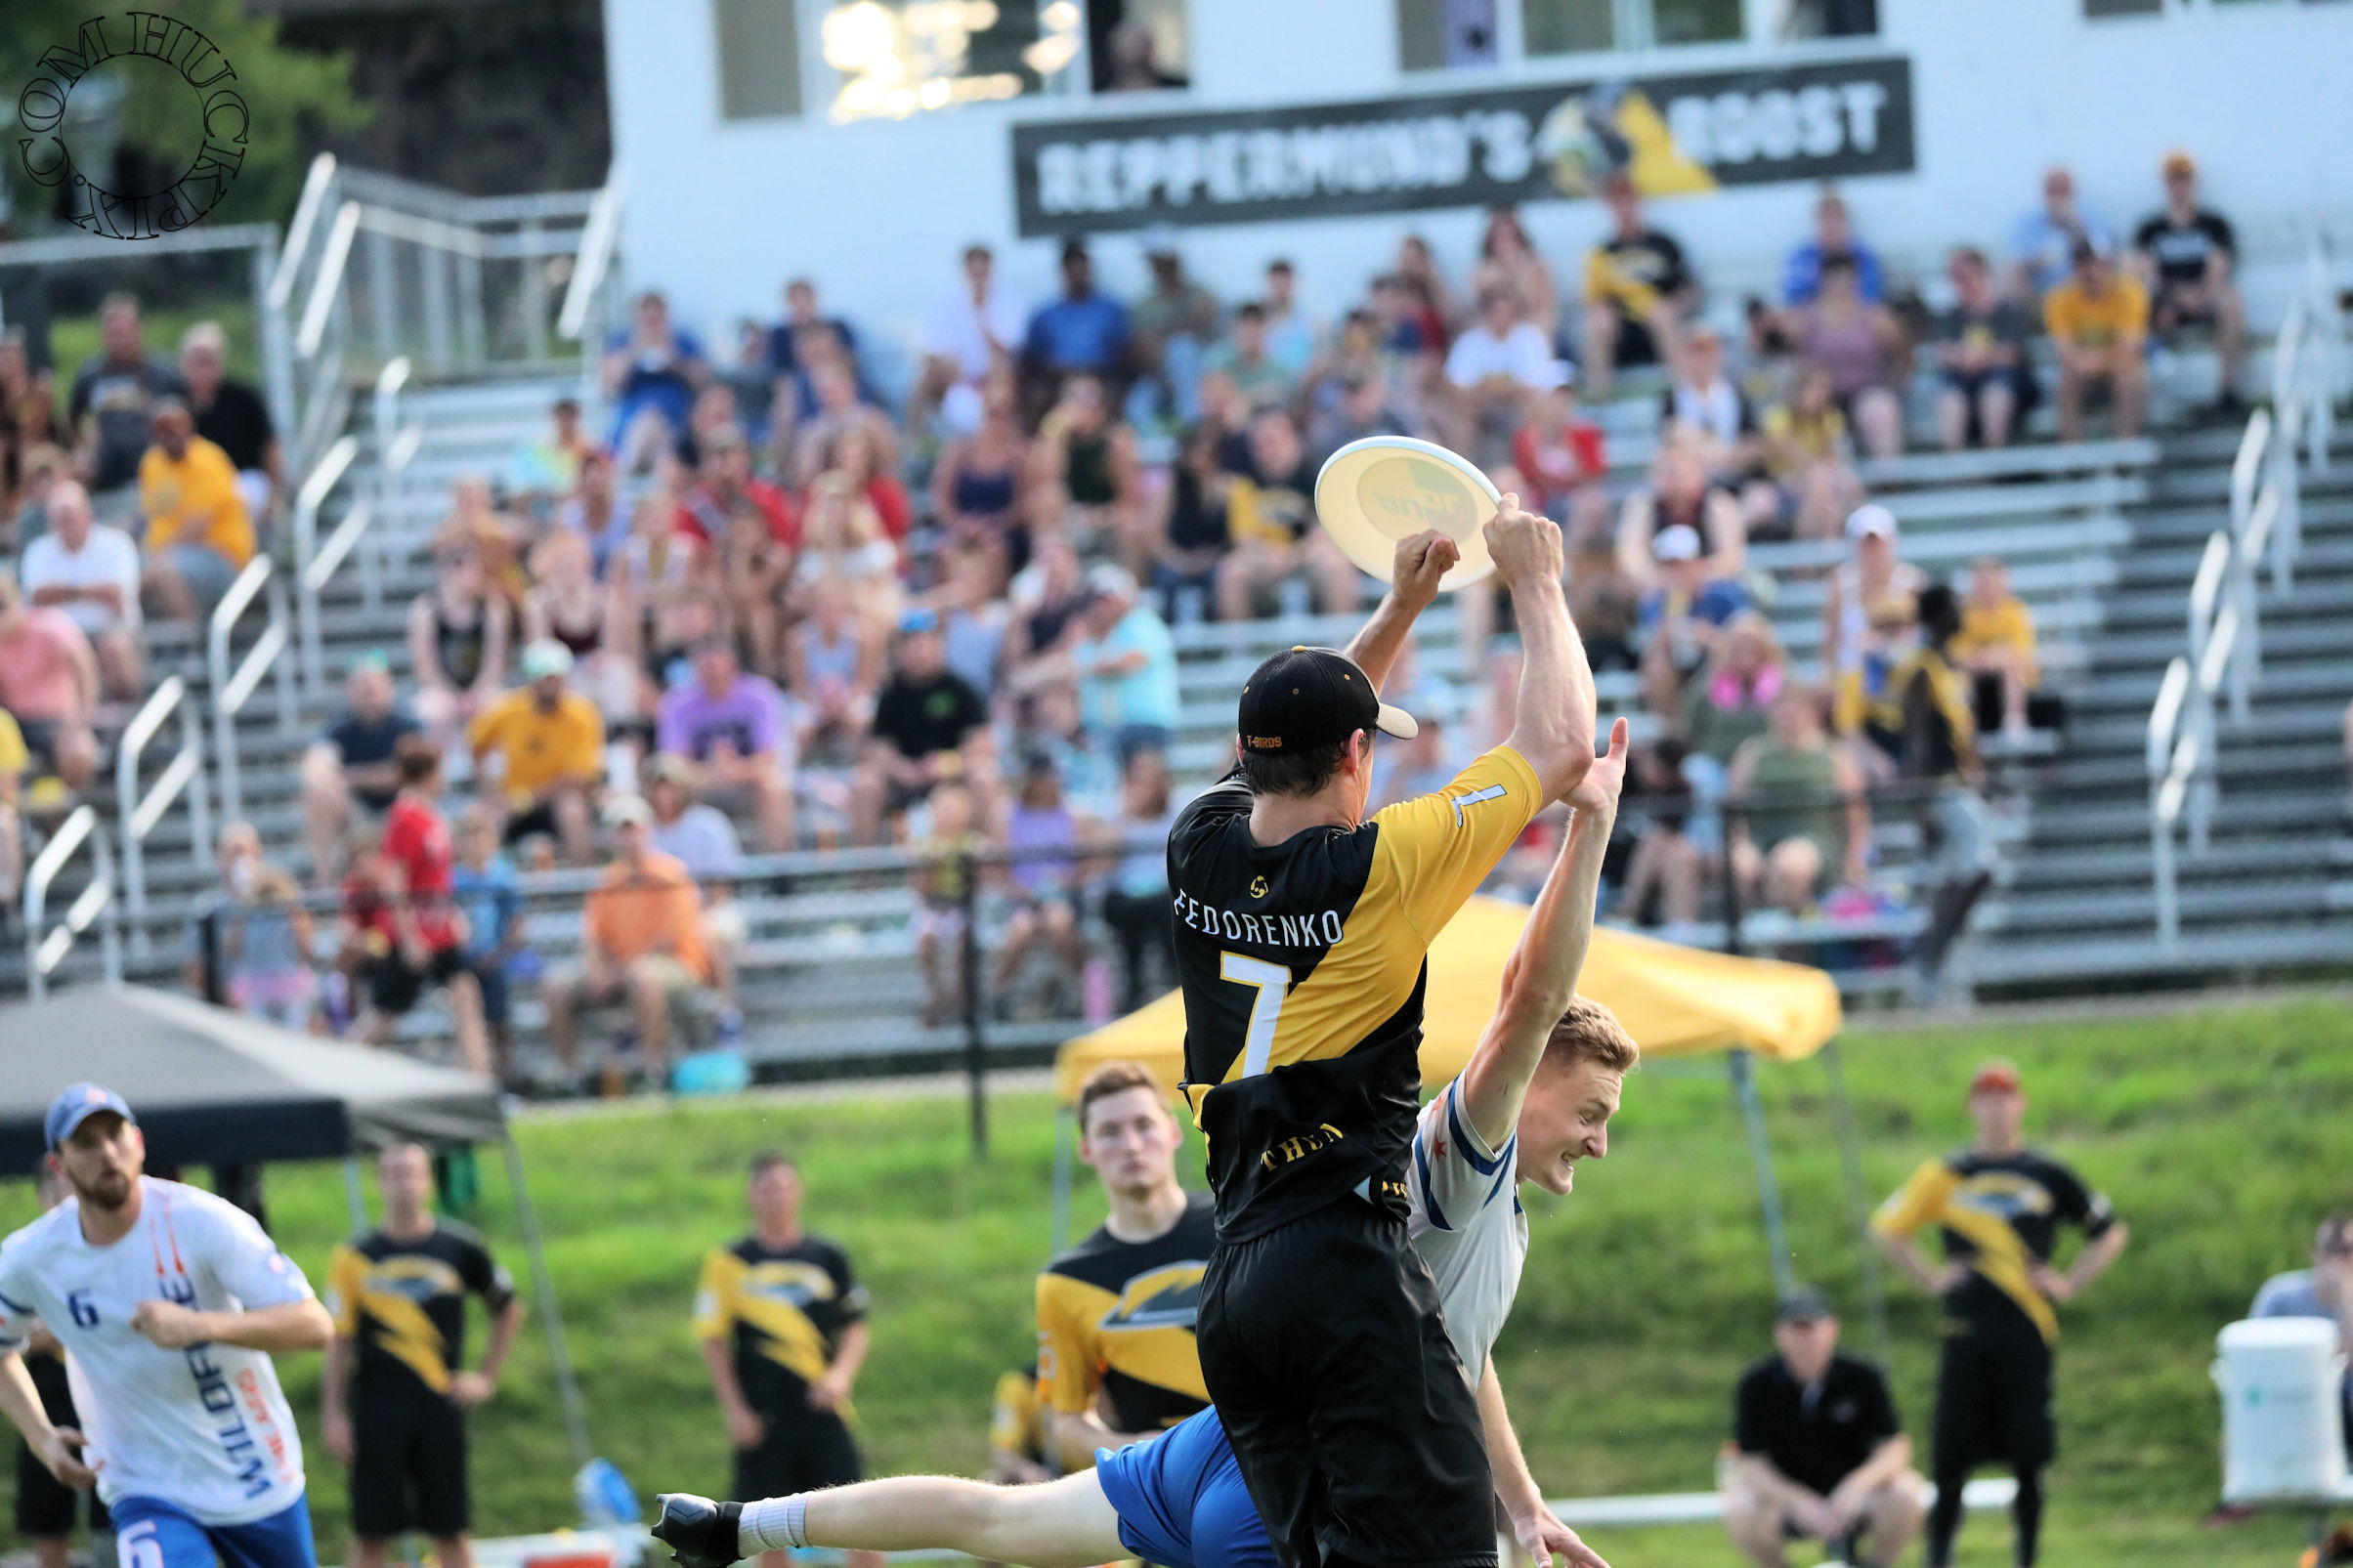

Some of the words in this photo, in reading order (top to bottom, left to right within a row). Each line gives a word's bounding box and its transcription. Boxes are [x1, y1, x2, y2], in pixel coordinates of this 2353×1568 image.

[1246, 735, 1283, 749] T-BIRDS
[1173, 888, 1345, 948] FEDORENKO
[1219, 950, 1293, 1080] 7
[67, 1288, 100, 1330] 6
